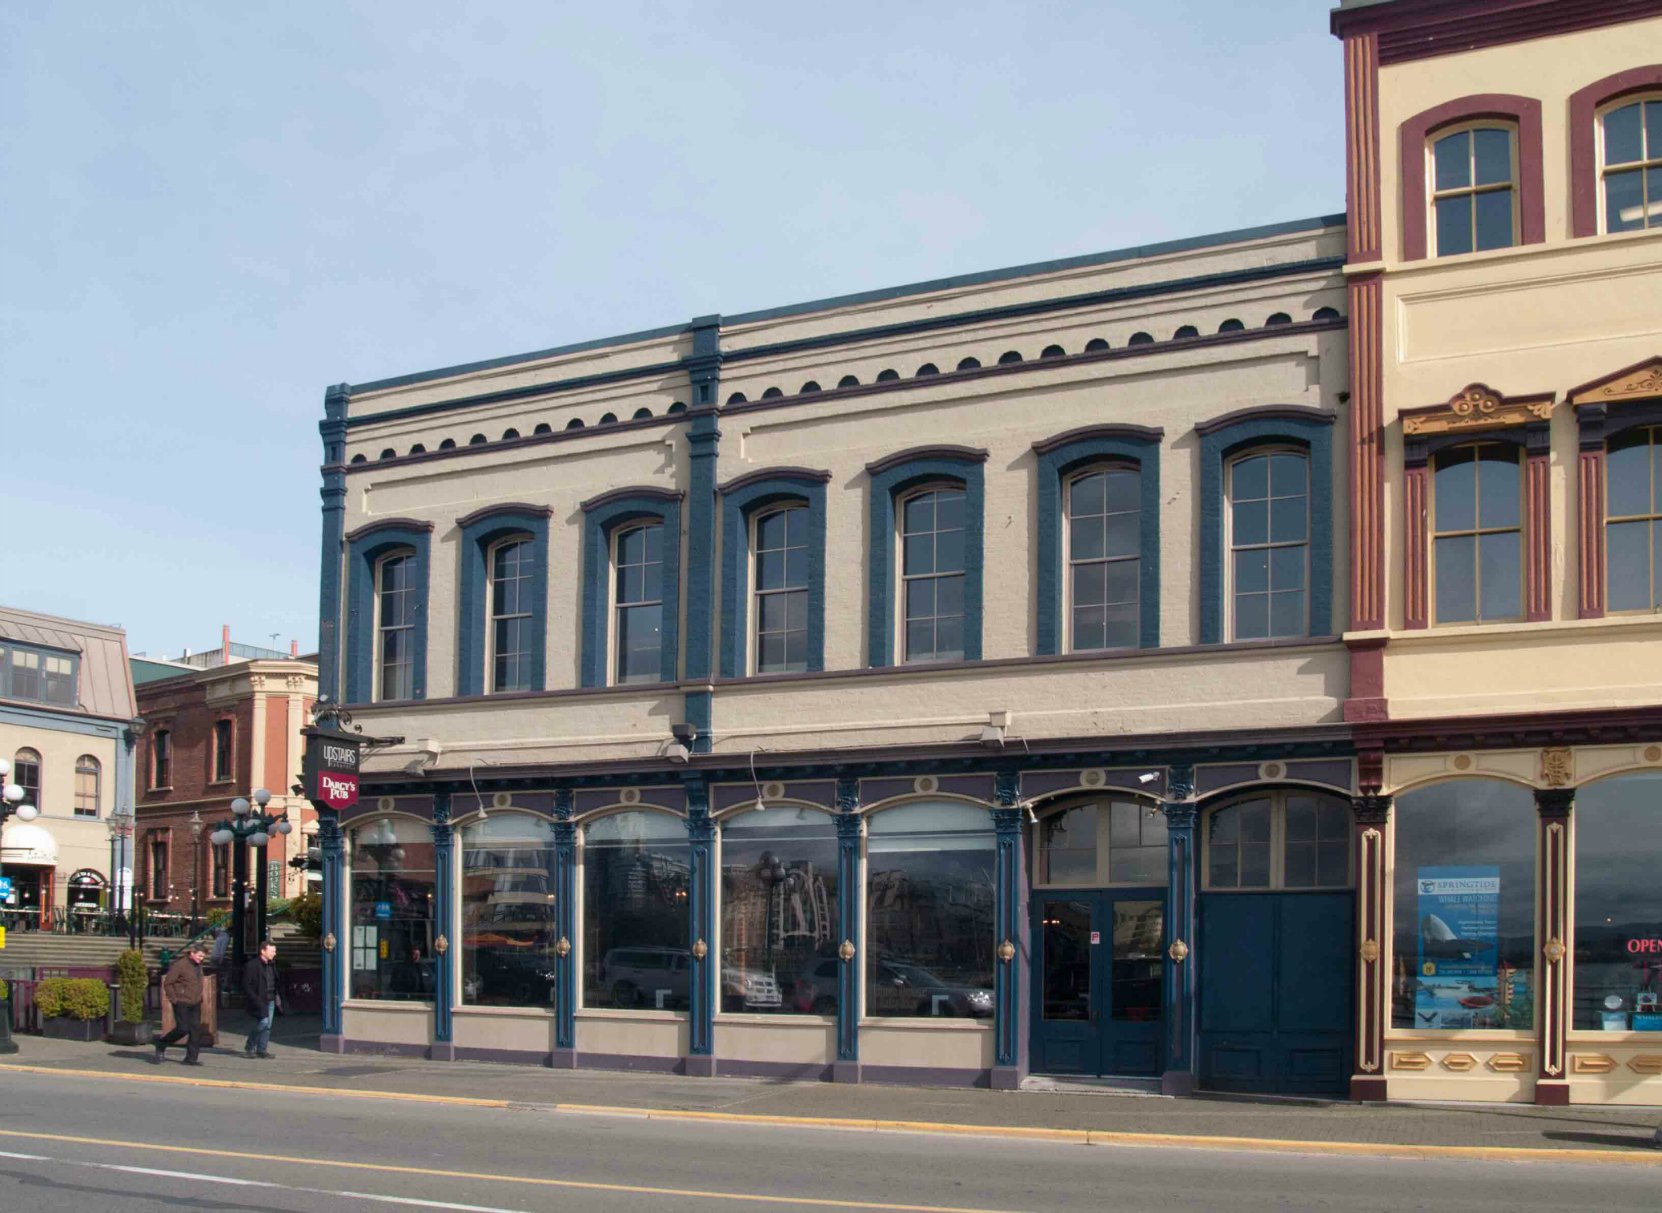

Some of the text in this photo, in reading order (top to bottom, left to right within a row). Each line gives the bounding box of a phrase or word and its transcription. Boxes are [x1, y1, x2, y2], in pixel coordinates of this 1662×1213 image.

[323, 745, 355, 766] UPSTAIRS
[322, 776, 355, 791] DARCY'S
[330, 788, 348, 799] PUB
[1438, 880, 1496, 889] SPRINGTIDE
